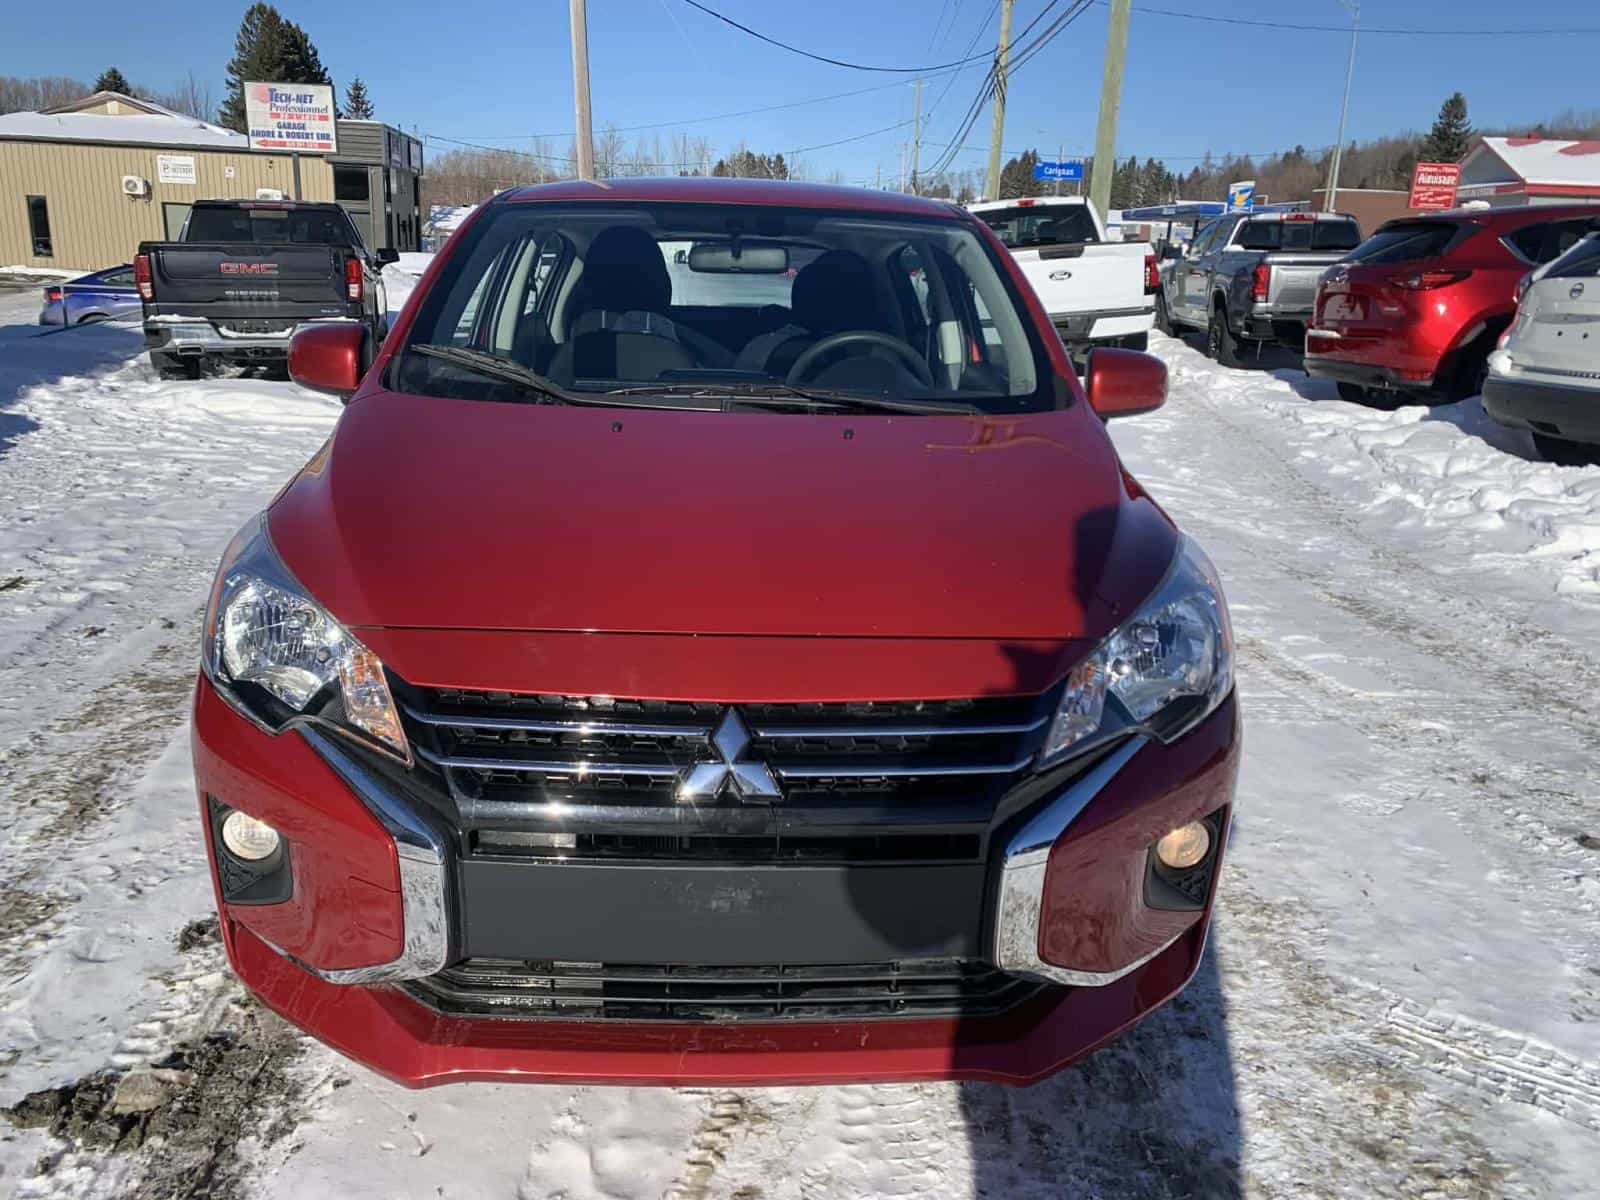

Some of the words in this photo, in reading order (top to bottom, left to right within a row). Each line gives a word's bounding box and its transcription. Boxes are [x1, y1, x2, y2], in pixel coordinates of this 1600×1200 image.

[270, 103, 328, 113] Professionnel
[277, 122, 305, 130] GARAGE
[286, 132, 314, 140] ROBERT
[220, 263, 279, 274] GMC
